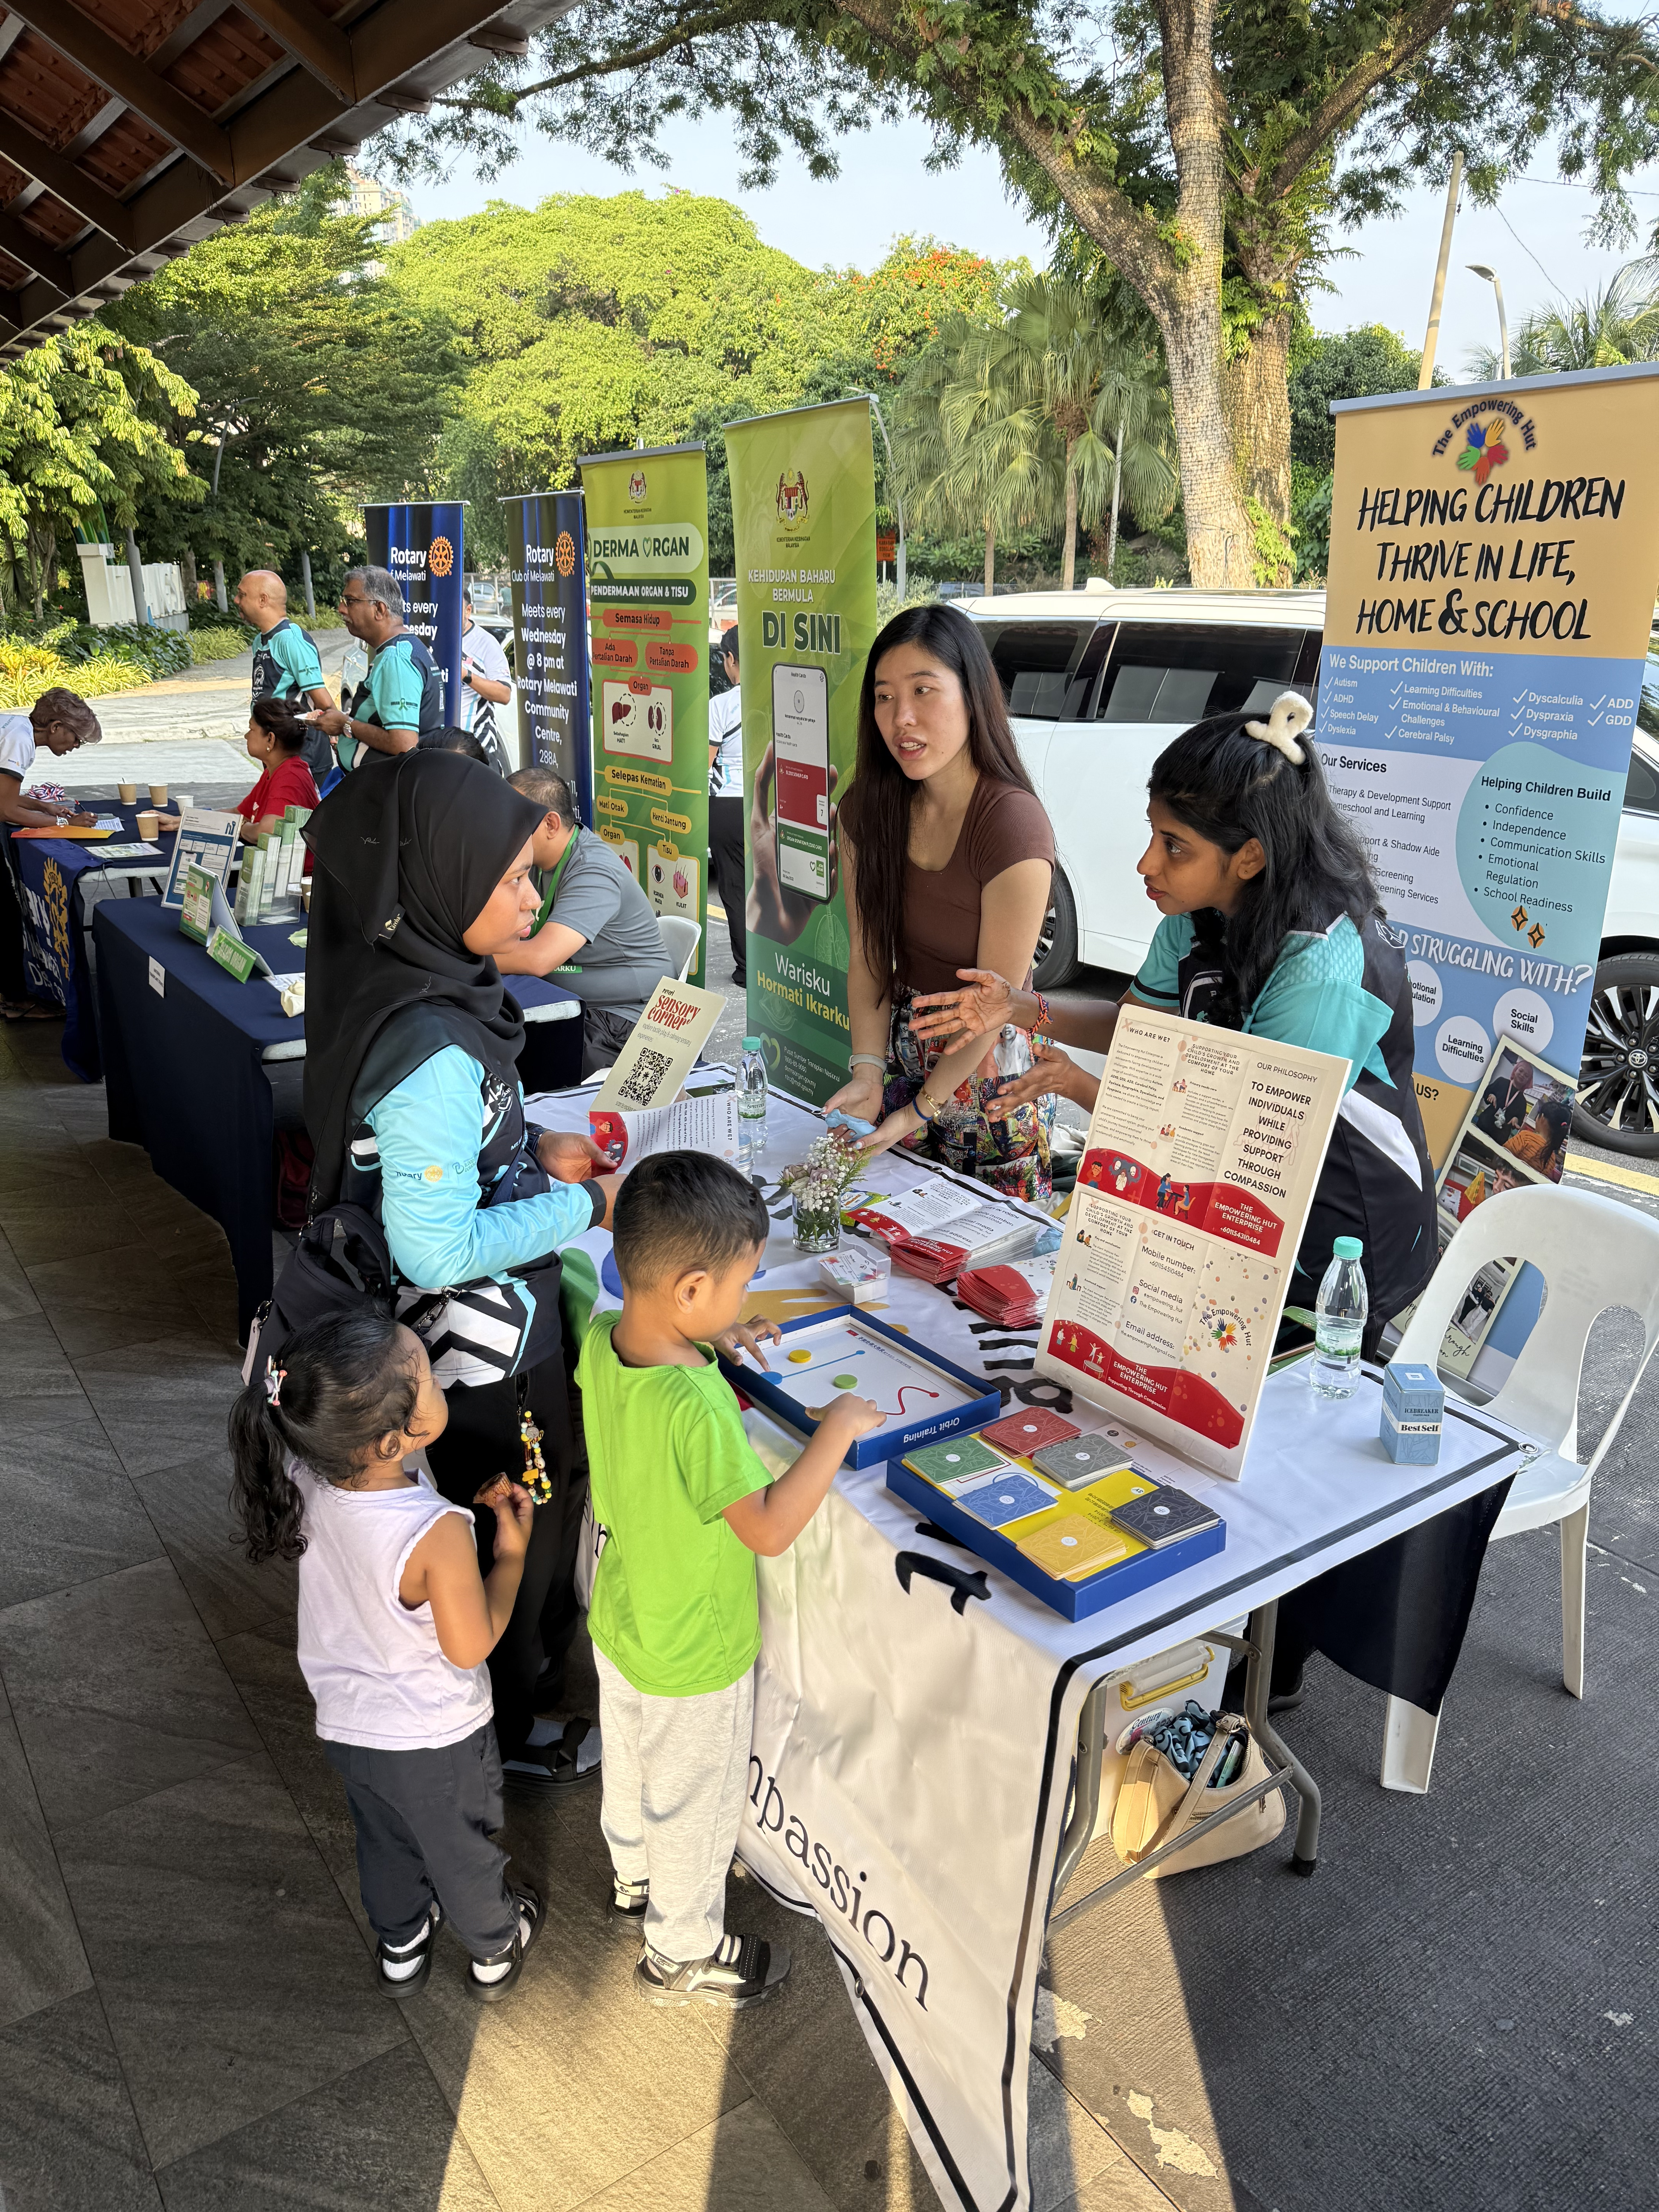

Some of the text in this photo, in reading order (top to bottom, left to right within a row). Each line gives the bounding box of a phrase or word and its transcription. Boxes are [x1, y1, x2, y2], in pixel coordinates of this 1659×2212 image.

[1432, 400, 1537, 457] The Empowering Hut
[1357, 477, 1625, 532] HELPING CHILDREN
[391, 547, 426, 567] Rotary
[526, 544, 554, 567] Rotary
[594, 539, 639, 557] DERMA
[1377, 539, 1576, 586] THRIVE IN LIFE,
[395, 570, 426, 581] Melawati
[512, 569, 555, 582] Club of Melawati
[749, 569, 835, 584] KEHIDUPAN BAHARU
[591, 586, 688, 598] PENDERMAAN ORGAN & TISU
[773, 588, 814, 602] BERMULA
[413, 603, 438, 618] every
[522, 603, 565, 623] Meets every
[1355, 588, 1592, 640] HOME & SCHOOL
[615, 613, 660, 627] Semasa Hidup
[521, 627, 566, 649] Wednesday
[762, 610, 841, 655] DI SINI
[615, 654, 632, 663] Darah
[659, 647, 674, 656] Tanpa
[527, 653, 564, 672] @ 8 pm at
[671, 659, 689, 668] Darah
[1330, 654, 1494, 677] We Support Children With:
[517, 675, 577, 697] Rotary Melawati
[633, 681, 648, 691] Organ
[1334, 678, 1357, 687] Autism
[1405, 684, 1482, 699] Learning Difficulties
[1333, 694, 1353, 703] ADHD
[1529, 692, 1583, 705] Dyscalculia
[1607, 698, 1633, 709] ADD
[525, 700, 569, 724] Community
[1330, 709, 1379, 723] Speech Delay
[1403, 700, 1500, 717] Emotional & Behavioural
[1526, 709, 1574, 722] Dyspraxia
[1401, 714, 1445, 727] Challenges
[1606, 715, 1632, 725] GDD
[535, 725, 562, 745] Centre,
[1328, 724, 1356, 735] Dyslexia
[1398, 729, 1454, 745] Cerebral Palsy
[1524, 726, 1578, 740] Dysgraphia
[539, 749, 558, 768] 288A,
[1321, 753, 1387, 772] Our Services
[611, 769, 666, 790] Selepas Kematian
[1481, 776, 1611, 801] Helping Children Build
[599, 800, 624, 812] Mati Otak
[1329, 785, 1451, 811] Therapy & Development Support
[1374, 807, 1425, 824] and Learning
[1495, 803, 1553, 820] Confidence
[665, 815, 686, 830] Jantung
[1493, 820, 1566, 840] Independence
[603, 828, 620, 840] Organ
[663, 845, 672, 855] Tisu
[1382, 839, 1440, 857] & Shadow Aide
[1491, 837, 1606, 864] Communication Skills
[1488, 854, 1538, 871] Emotional
[1487, 871, 1538, 888] Regulation
[1408, 889, 1438, 904] Services
[1484, 887, 1573, 912] School Readiness
[1411, 934, 1594, 995] STRUGGLING WITH?
[775, 952, 830, 996] Warisku
[655, 995, 701, 1024] sensory
[757, 970, 850, 1031] Hormati Ikrarku
[647, 1007, 687, 1030] corner
[1511, 1008, 1538, 1024] Social
[1511, 1020, 1534, 1034] Skills
[1442, 1043, 1484, 1063] Difficulties
[1448, 1034, 1483, 1054] Learning
[1257, 1062, 1317, 1082] OUR PHILOSOPHY
[1252, 1081, 1311, 1105] TO EMPOWER
[1416, 1083, 1439, 1101] US?
[1249, 1097, 1305, 1120] INDIVIDUALS
[1259, 1116, 1285, 1131] WHILE
[1243, 1128, 1292, 1149] PROVIDING
[1243, 1144, 1284, 1163] SUPPORT
[1238, 1158, 1281, 1179] THROUGH
[1224, 1170, 1286, 1198] COMPASSION
[1142, 1245, 1196, 1274] Mobile number:
[1139, 1279, 1183, 1304] Social media
[1126, 1321, 1175, 1349] Email address:
[903, 1417, 960, 1443] Orbit Training
[1132, 1711, 1162, 1729] Century
